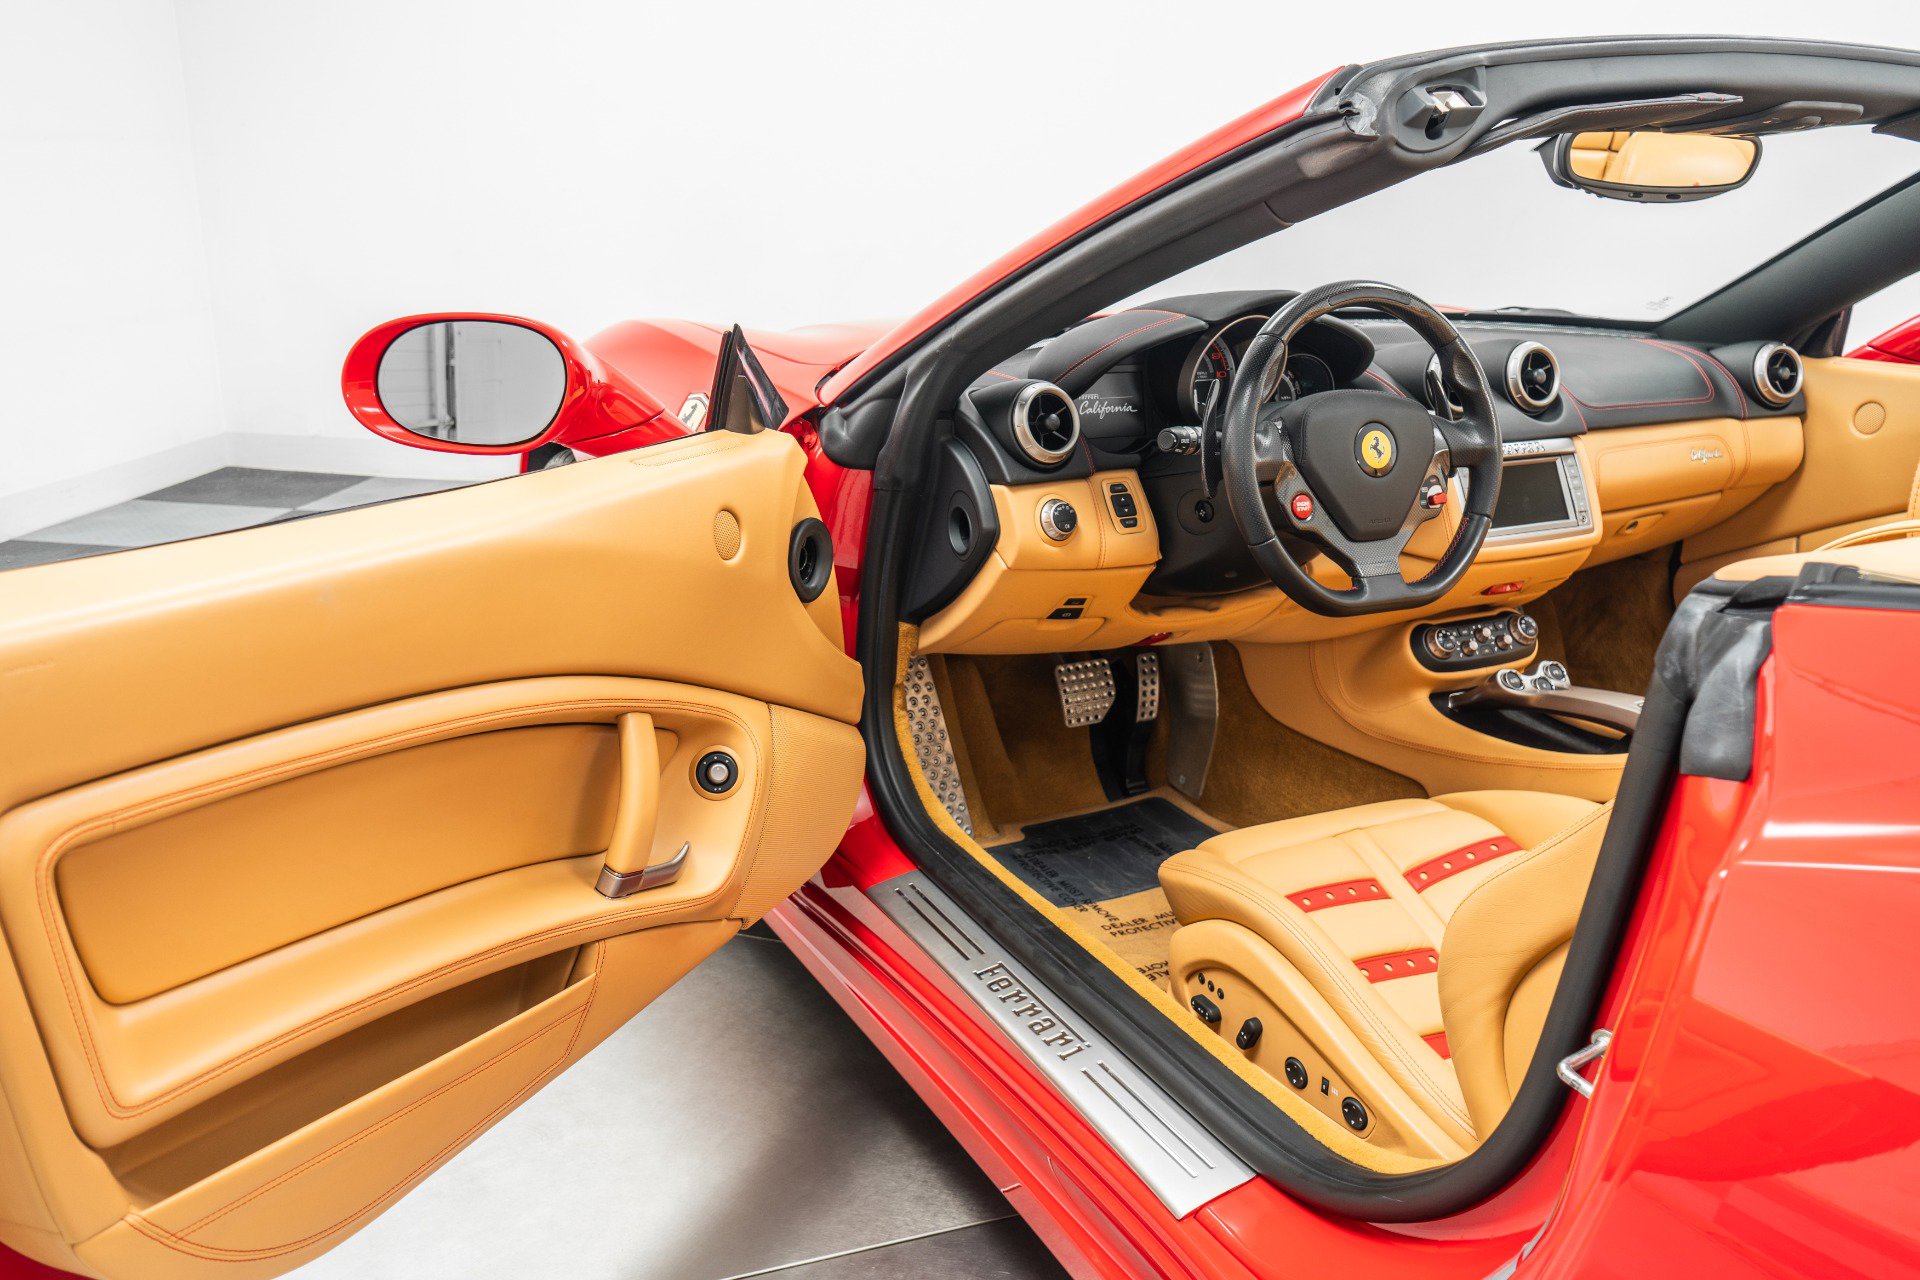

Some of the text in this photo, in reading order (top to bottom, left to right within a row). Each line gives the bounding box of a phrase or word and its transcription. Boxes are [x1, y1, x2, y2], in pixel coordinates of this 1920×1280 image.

[1079, 400, 1138, 420] California
[1058, 880, 1085, 898] MUST
[1101, 916, 1149, 931] DEALER
[972, 960, 1092, 1061] Ferrari
